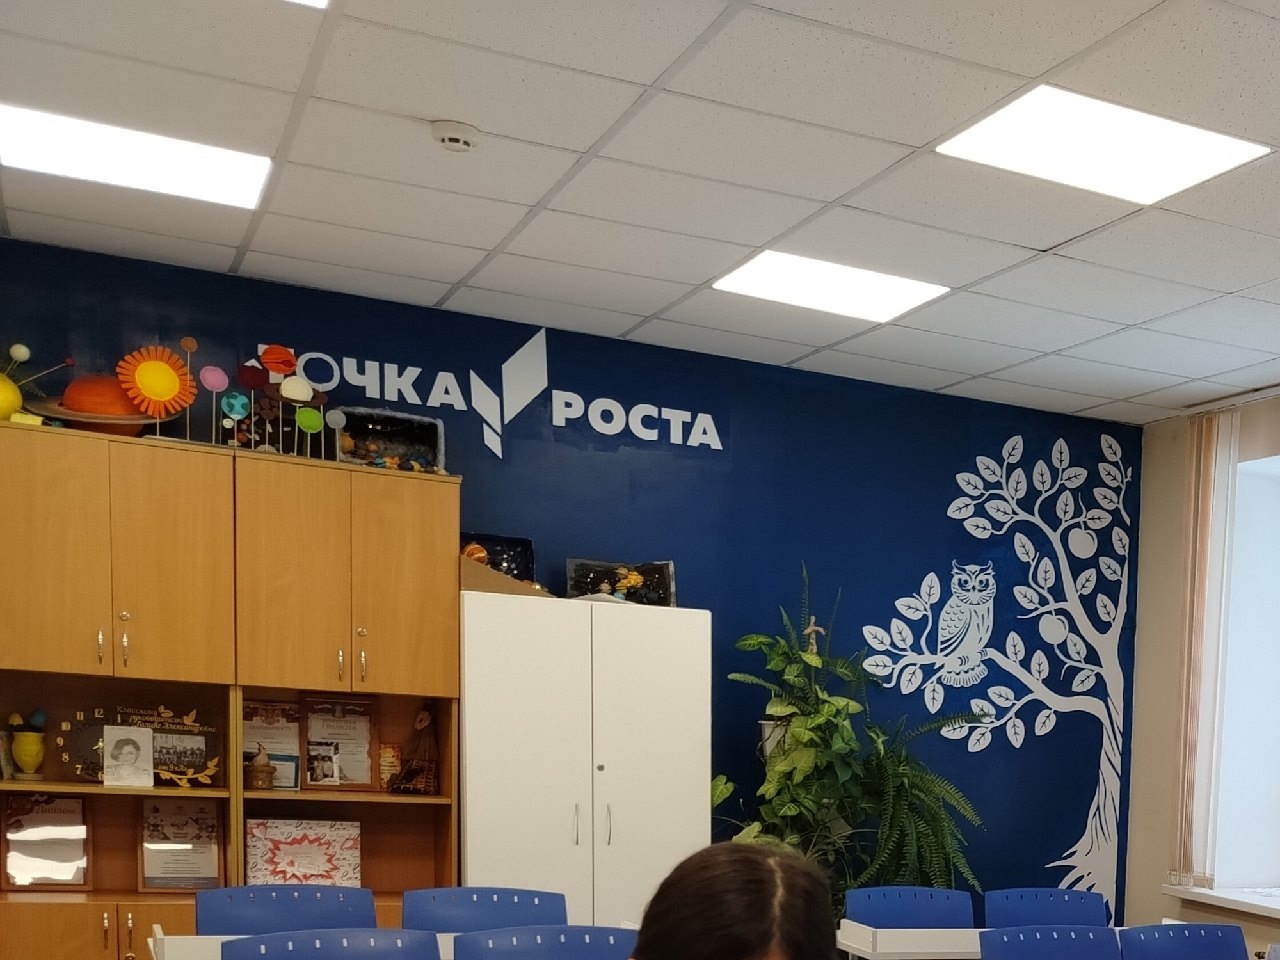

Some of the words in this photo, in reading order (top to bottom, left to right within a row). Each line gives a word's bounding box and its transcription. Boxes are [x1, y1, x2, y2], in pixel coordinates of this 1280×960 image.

[552, 389, 724, 450] РОСТА
[76, 711, 84, 720] 11
[94, 708, 104, 718] 12
[56, 736, 64, 747] 9
[62, 752, 69, 763] 8
[75, 764, 82, 774] 7
